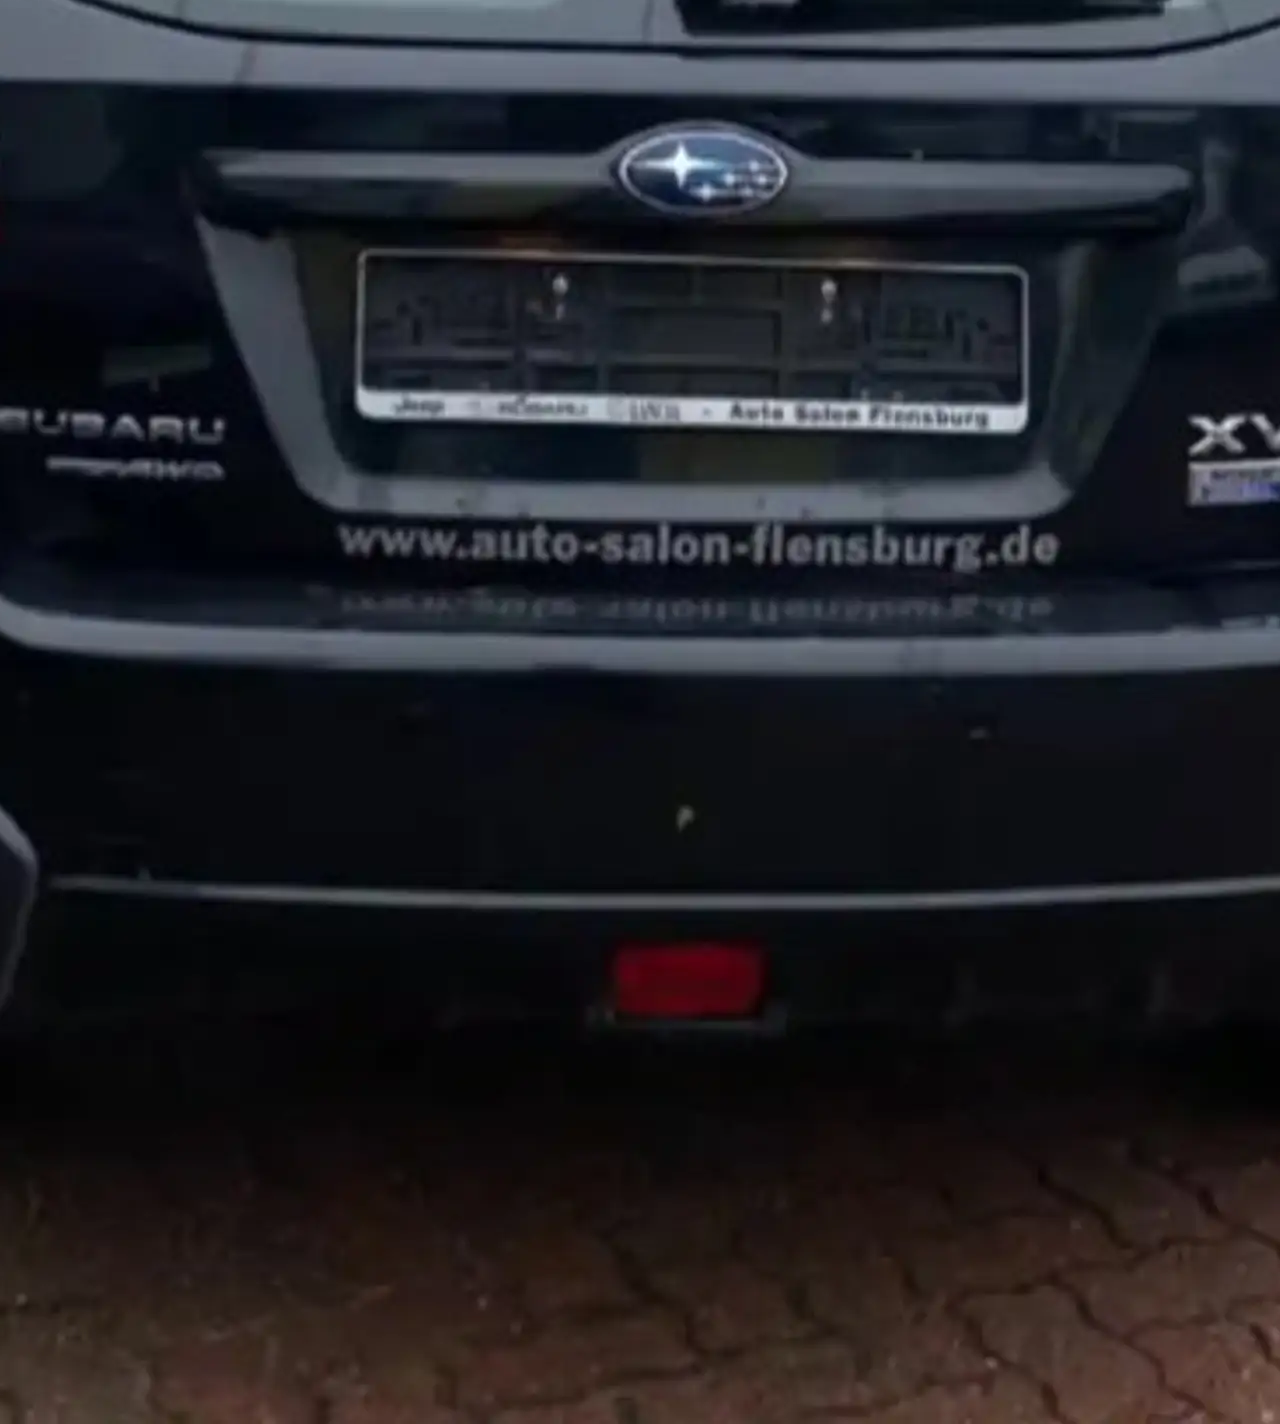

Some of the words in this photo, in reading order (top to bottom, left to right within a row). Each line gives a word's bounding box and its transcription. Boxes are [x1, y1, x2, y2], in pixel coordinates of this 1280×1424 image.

[729, 398, 785, 423] Auto
[794, 400, 863, 425] Salon
[869, 402, 990, 431] Flensburg
[337, 521, 1062, 574] www.auto-salon-flensburg.de
